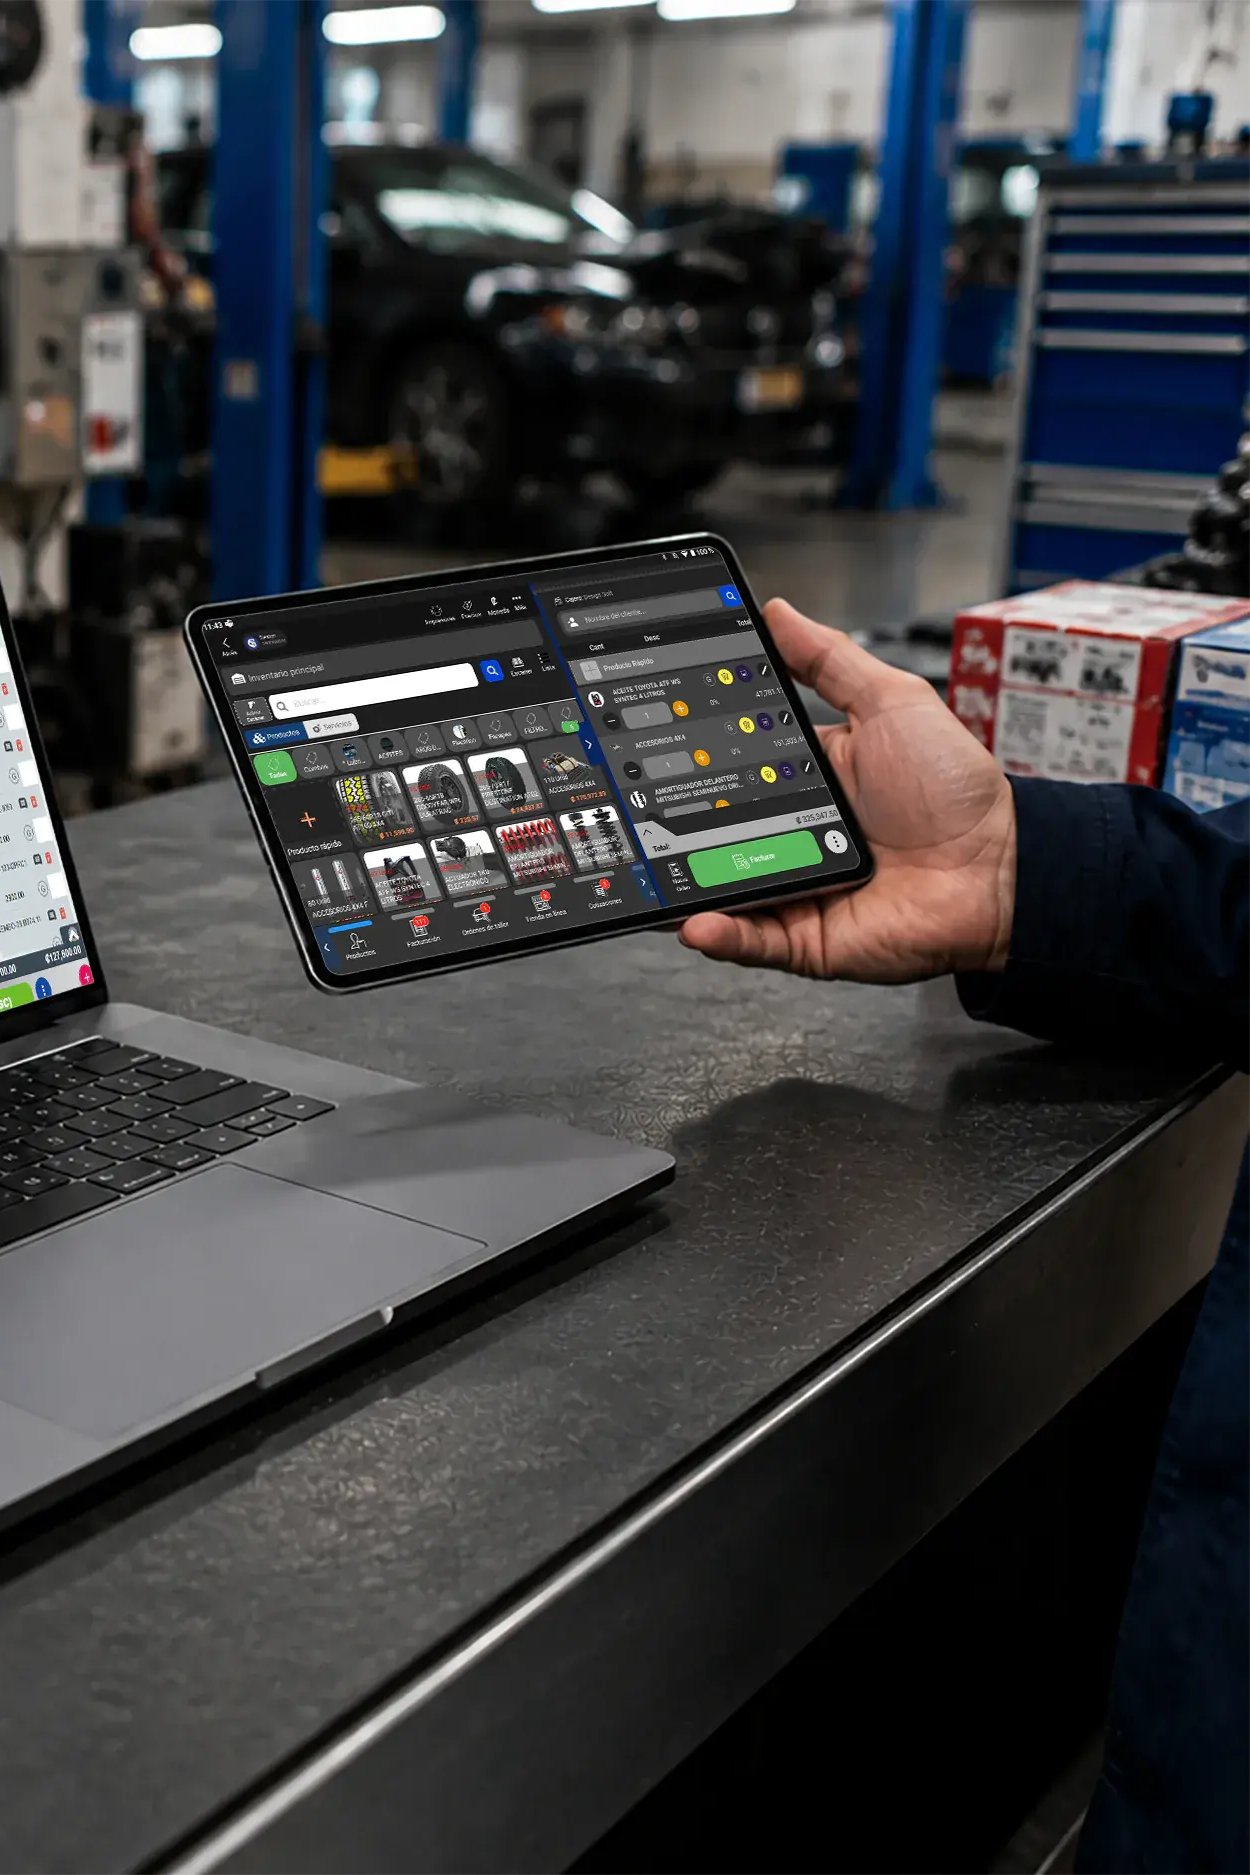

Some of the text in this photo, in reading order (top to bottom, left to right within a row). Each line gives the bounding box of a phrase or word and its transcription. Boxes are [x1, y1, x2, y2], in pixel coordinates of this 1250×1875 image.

[203, 621, 223, 631] 11:43
[643, 633, 661, 642] Desc
[588, 642, 605, 651] Cant
[602, 661, 632, 671] Producto
[247, 662, 325, 682] Inventario principal
[322, 719, 353, 730] Servicios
[266, 728, 300, 739] Productos
[286, 843, 320, 855] Producto
[652, 842, 672, 853] Total:
[345, 949, 377, 960] Productos
